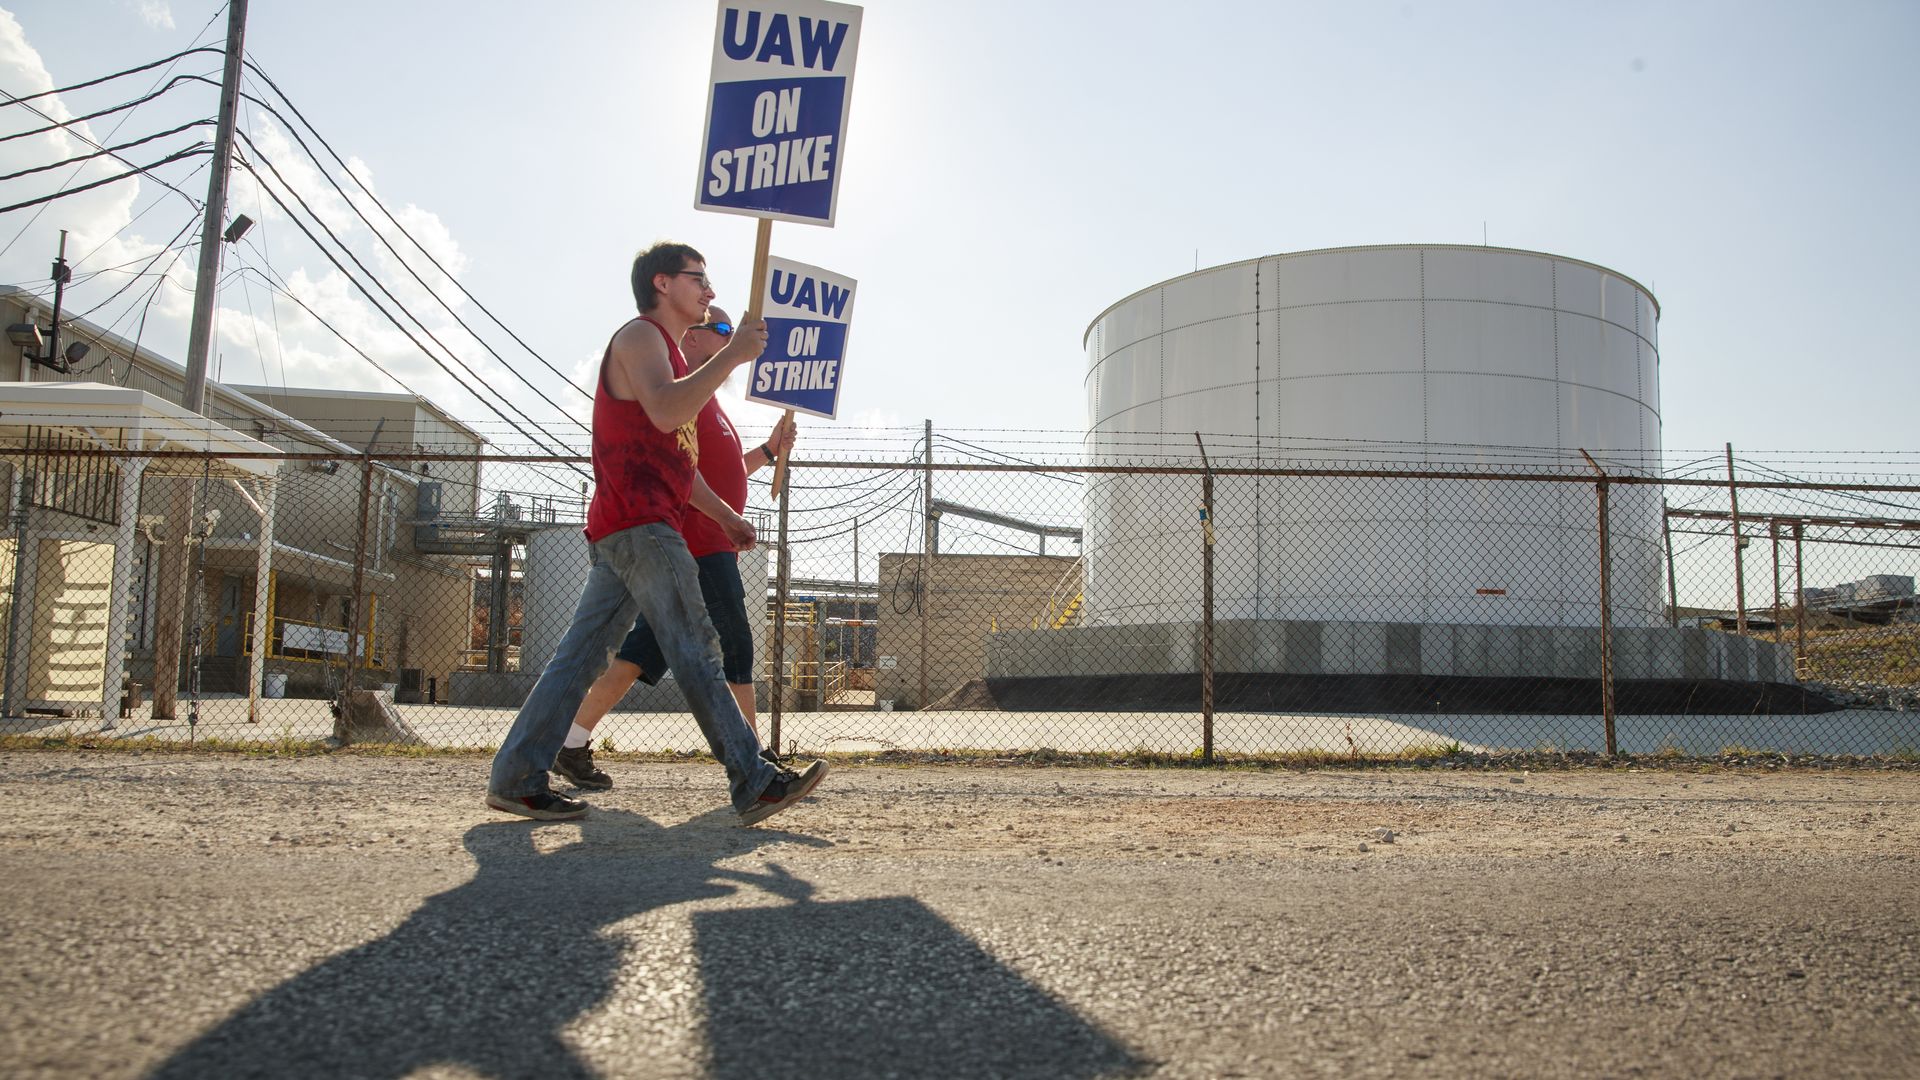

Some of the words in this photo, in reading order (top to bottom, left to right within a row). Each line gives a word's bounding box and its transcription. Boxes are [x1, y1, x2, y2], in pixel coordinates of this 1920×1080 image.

[722, 8, 849, 72] UAW
[752, 87, 801, 138] ON
[708, 135, 833, 197] STRIKE
[770, 269, 850, 320] UAW
[787, 326, 820, 357] ON
[756, 360, 838, 393] STRIKE
